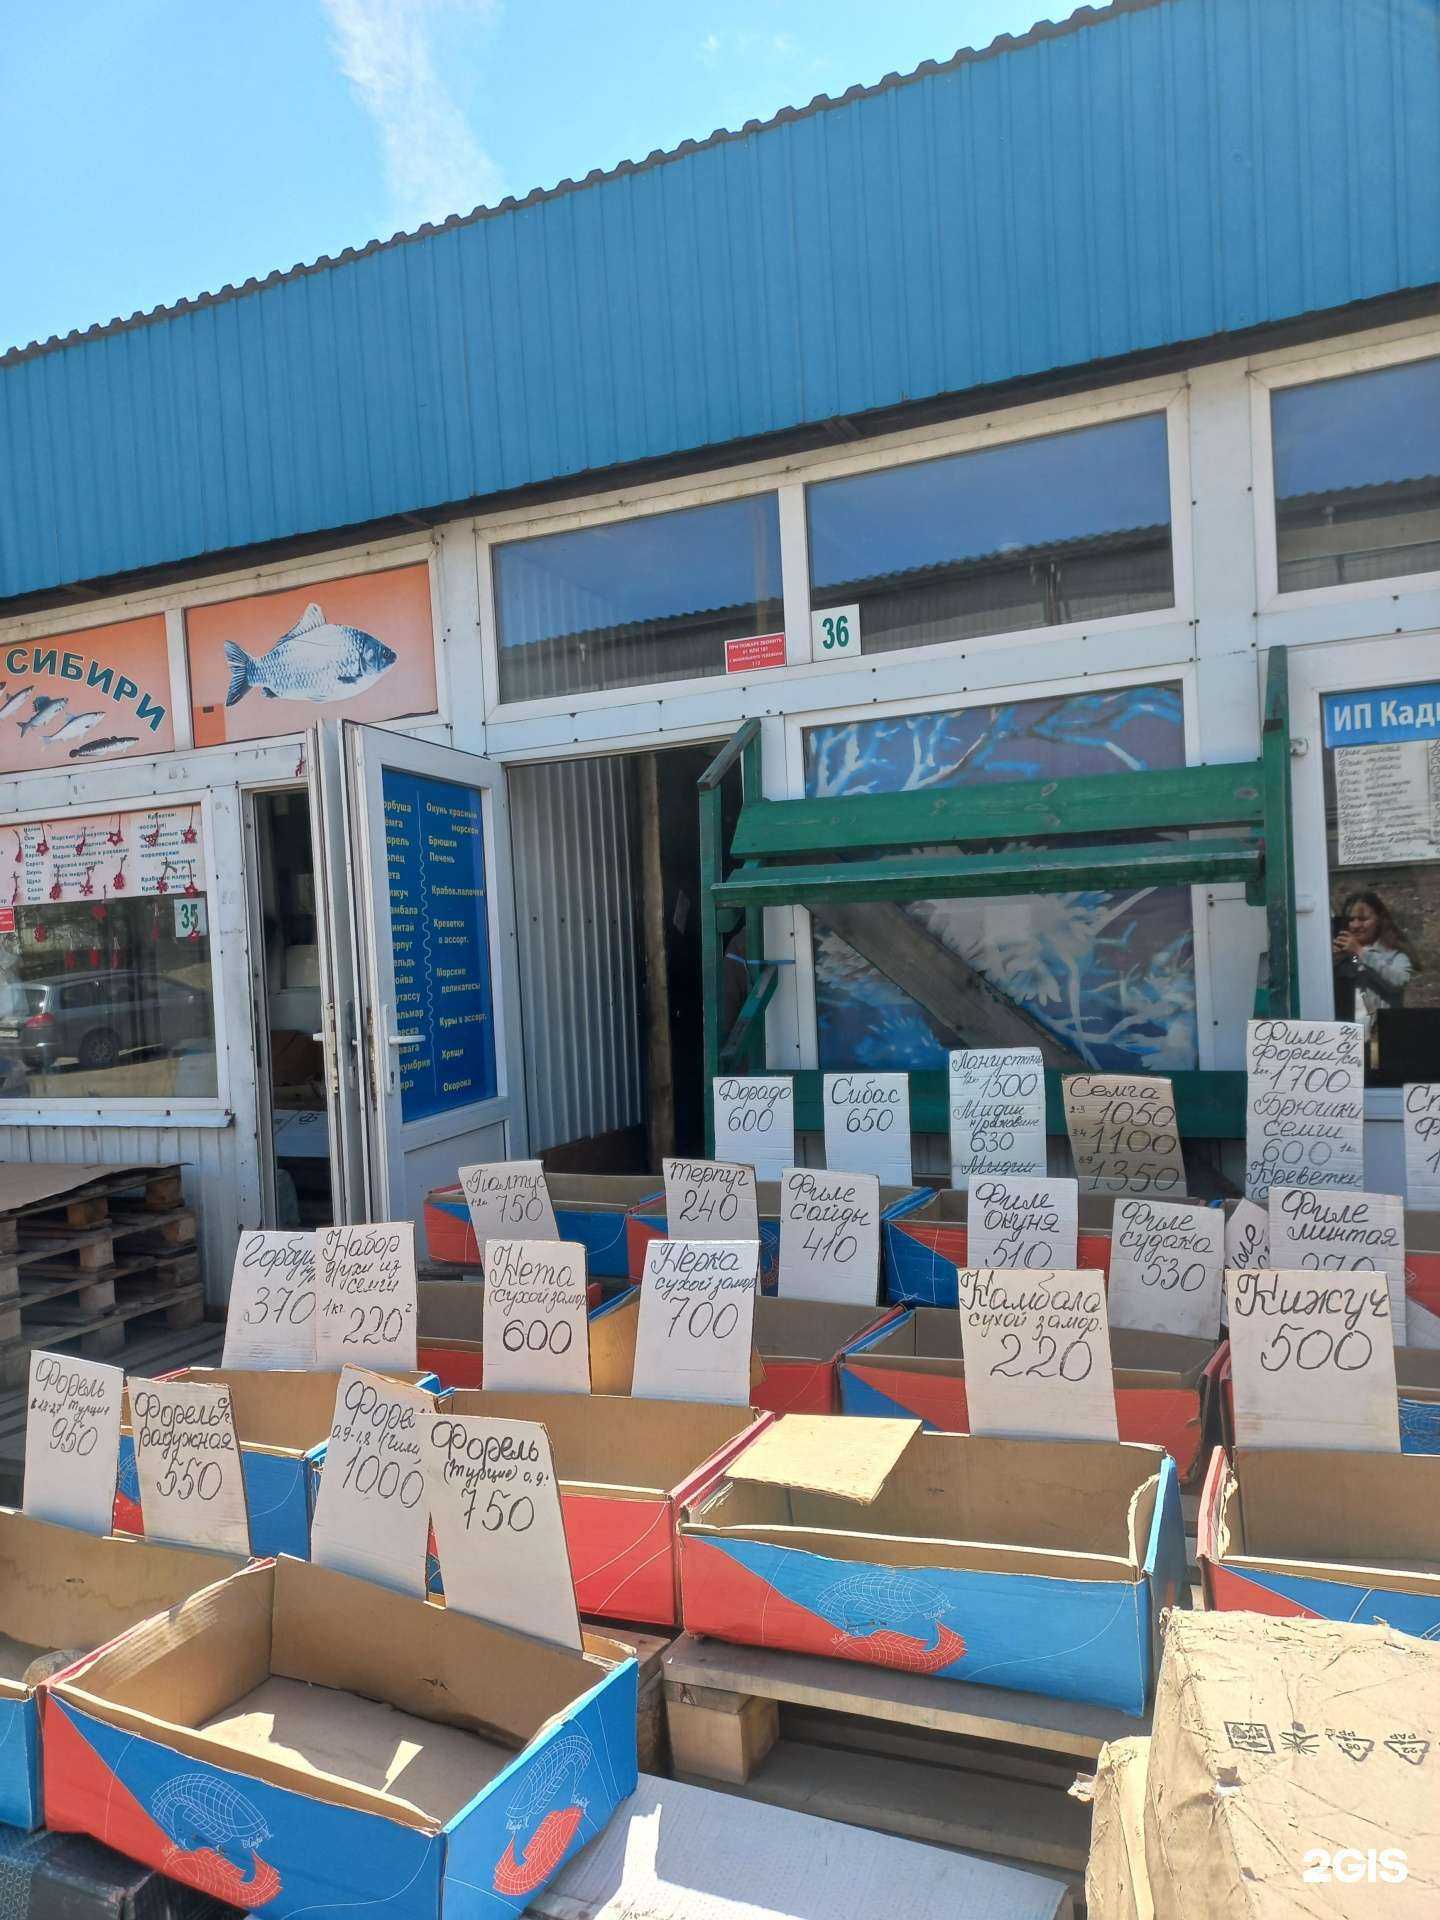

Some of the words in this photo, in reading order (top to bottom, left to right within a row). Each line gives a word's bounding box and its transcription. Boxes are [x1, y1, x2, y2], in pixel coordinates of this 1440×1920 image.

[822, 615, 849, 649] 36
[5, 647, 168, 731] СИБИРИ
[1334, 703, 1372, 732] ИП
[426, 802, 447, 816] Окунь
[386, 836, 410, 846] орель
[428, 835, 457, 848] Брюшки
[387, 854, 405, 864] олец
[390, 888, 409, 899] ижуч
[180, 903, 198, 929] 35
[392, 924, 415, 933] интай
[434, 918, 464, 930] Креветки
[392, 941, 412, 952] ерпуг
[395, 974, 414, 984] ойва
[396, 992, 421, 1005] утассу
[440, 1016, 457, 1028] Куры
[1254, 1021, 1334, 1046] Филе
[400, 1059, 431, 1074] кумбрия
[1270, 1064, 1351, 1093] 1700
[718, 1079, 792, 1107] Дорадо
[831, 1075, 904, 1105] Сибас
[979, 1074, 1038, 1099] 1500
[1069, 1076, 1161, 1100] Семга
[728, 1106, 774, 1132] 600
[846, 1107, 894, 1132] 650
[1094, 1100, 1176, 1127] 1050
[1254, 1092, 1362, 1118] Брюшки
[1091, 1127, 1177, 1156] 1100
[1262, 1138, 1332, 1165] 600
[466, 1168, 546, 1198] Палтус
[788, 1172, 856, 1202] Филе
[1087, 1160, 1180, 1193] 1350
[1247, 1161, 1363, 1187] Креветки
[496, 1194, 544, 1223] 750
[680, 1190, 738, 1222] 240
[975, 1182, 1056, 1212] Филе
[1281, 1189, 1370, 1223] Филе
[1122, 1201, 1197, 1232] Филе
[322, 1228, 400, 1261] Набор
[651, 1242, 745, 1274] Нерка
[802, 1227, 858, 1264] 410
[984, 1238, 1052, 1268] 510
[490, 1244, 576, 1288] Кета
[1141, 1257, 1206, 1292] 530
[243, 1286, 316, 1324] 370
[960, 1270, 1102, 1314] Камбала
[1235, 1273, 1391, 1329] Кижуч
[343, 1306, 403, 1345] 220
[668, 1296, 738, 1340] 700
[502, 1318, 573, 1355] 600
[1260, 1323, 1374, 1372] 500
[990, 1333, 1093, 1382] 220
[35, 1358, 105, 1406] Форель
[134, 1392, 220, 1433] Форель
[50, 1417, 98, 1456] 950
[431, 1420, 540, 1466] Форель
[157, 1450, 223, 1500] 550
[343, 1446, 424, 1508] 1000
[461, 1489, 535, 1532] 750
